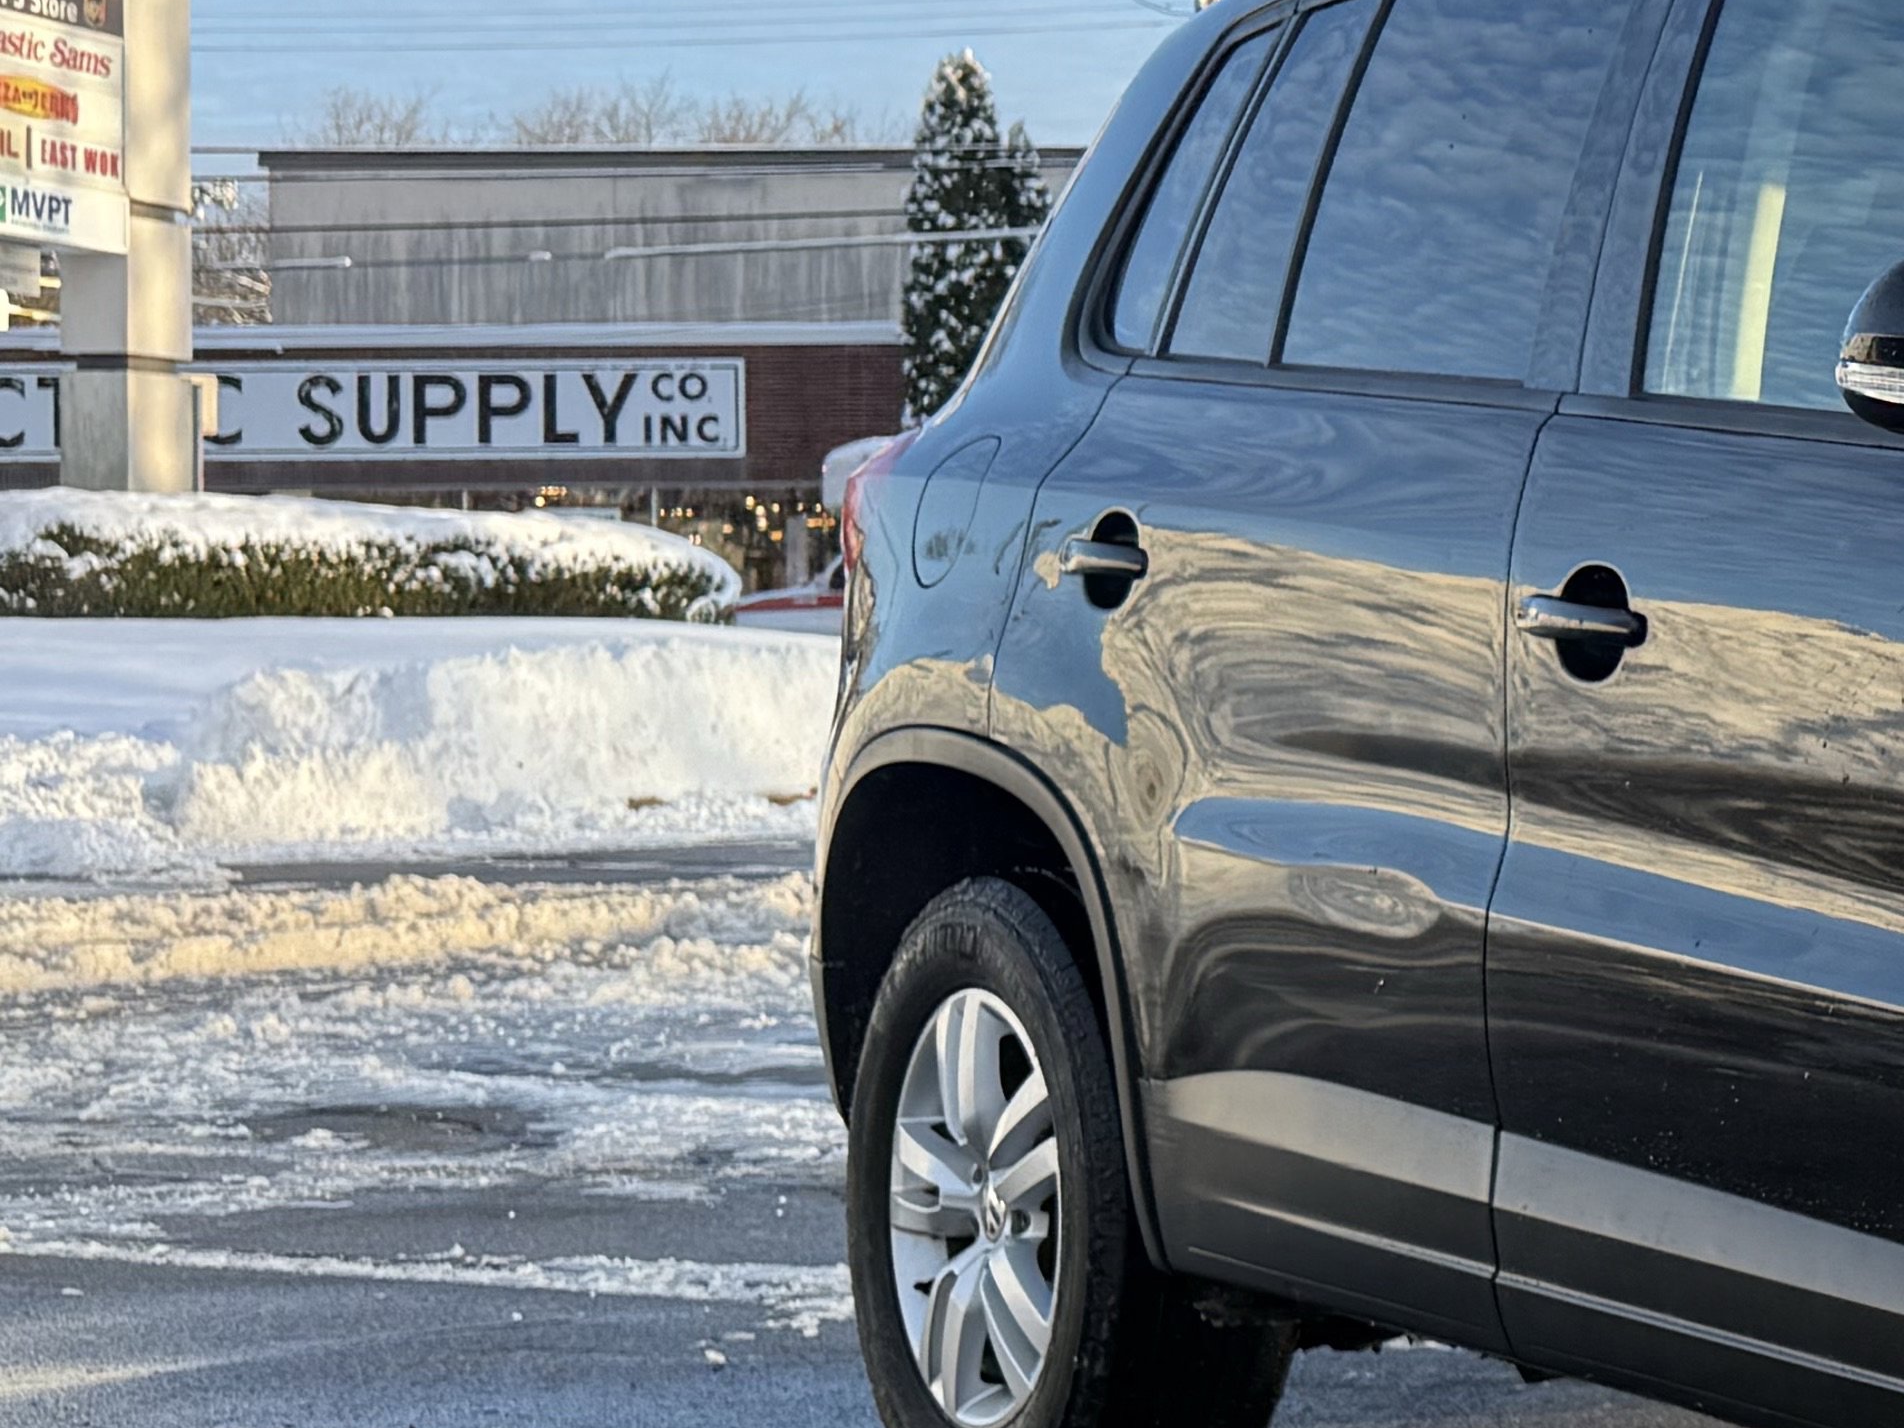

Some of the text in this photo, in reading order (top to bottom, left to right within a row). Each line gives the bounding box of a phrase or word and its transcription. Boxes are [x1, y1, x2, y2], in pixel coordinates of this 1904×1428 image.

[49, 36, 112, 78] Sams
[41, 138, 77, 171] EAST
[84, 147, 119, 179] WOK
[11, 186, 72, 226] MVPT
[298, 373, 637, 445] SUPPLY
